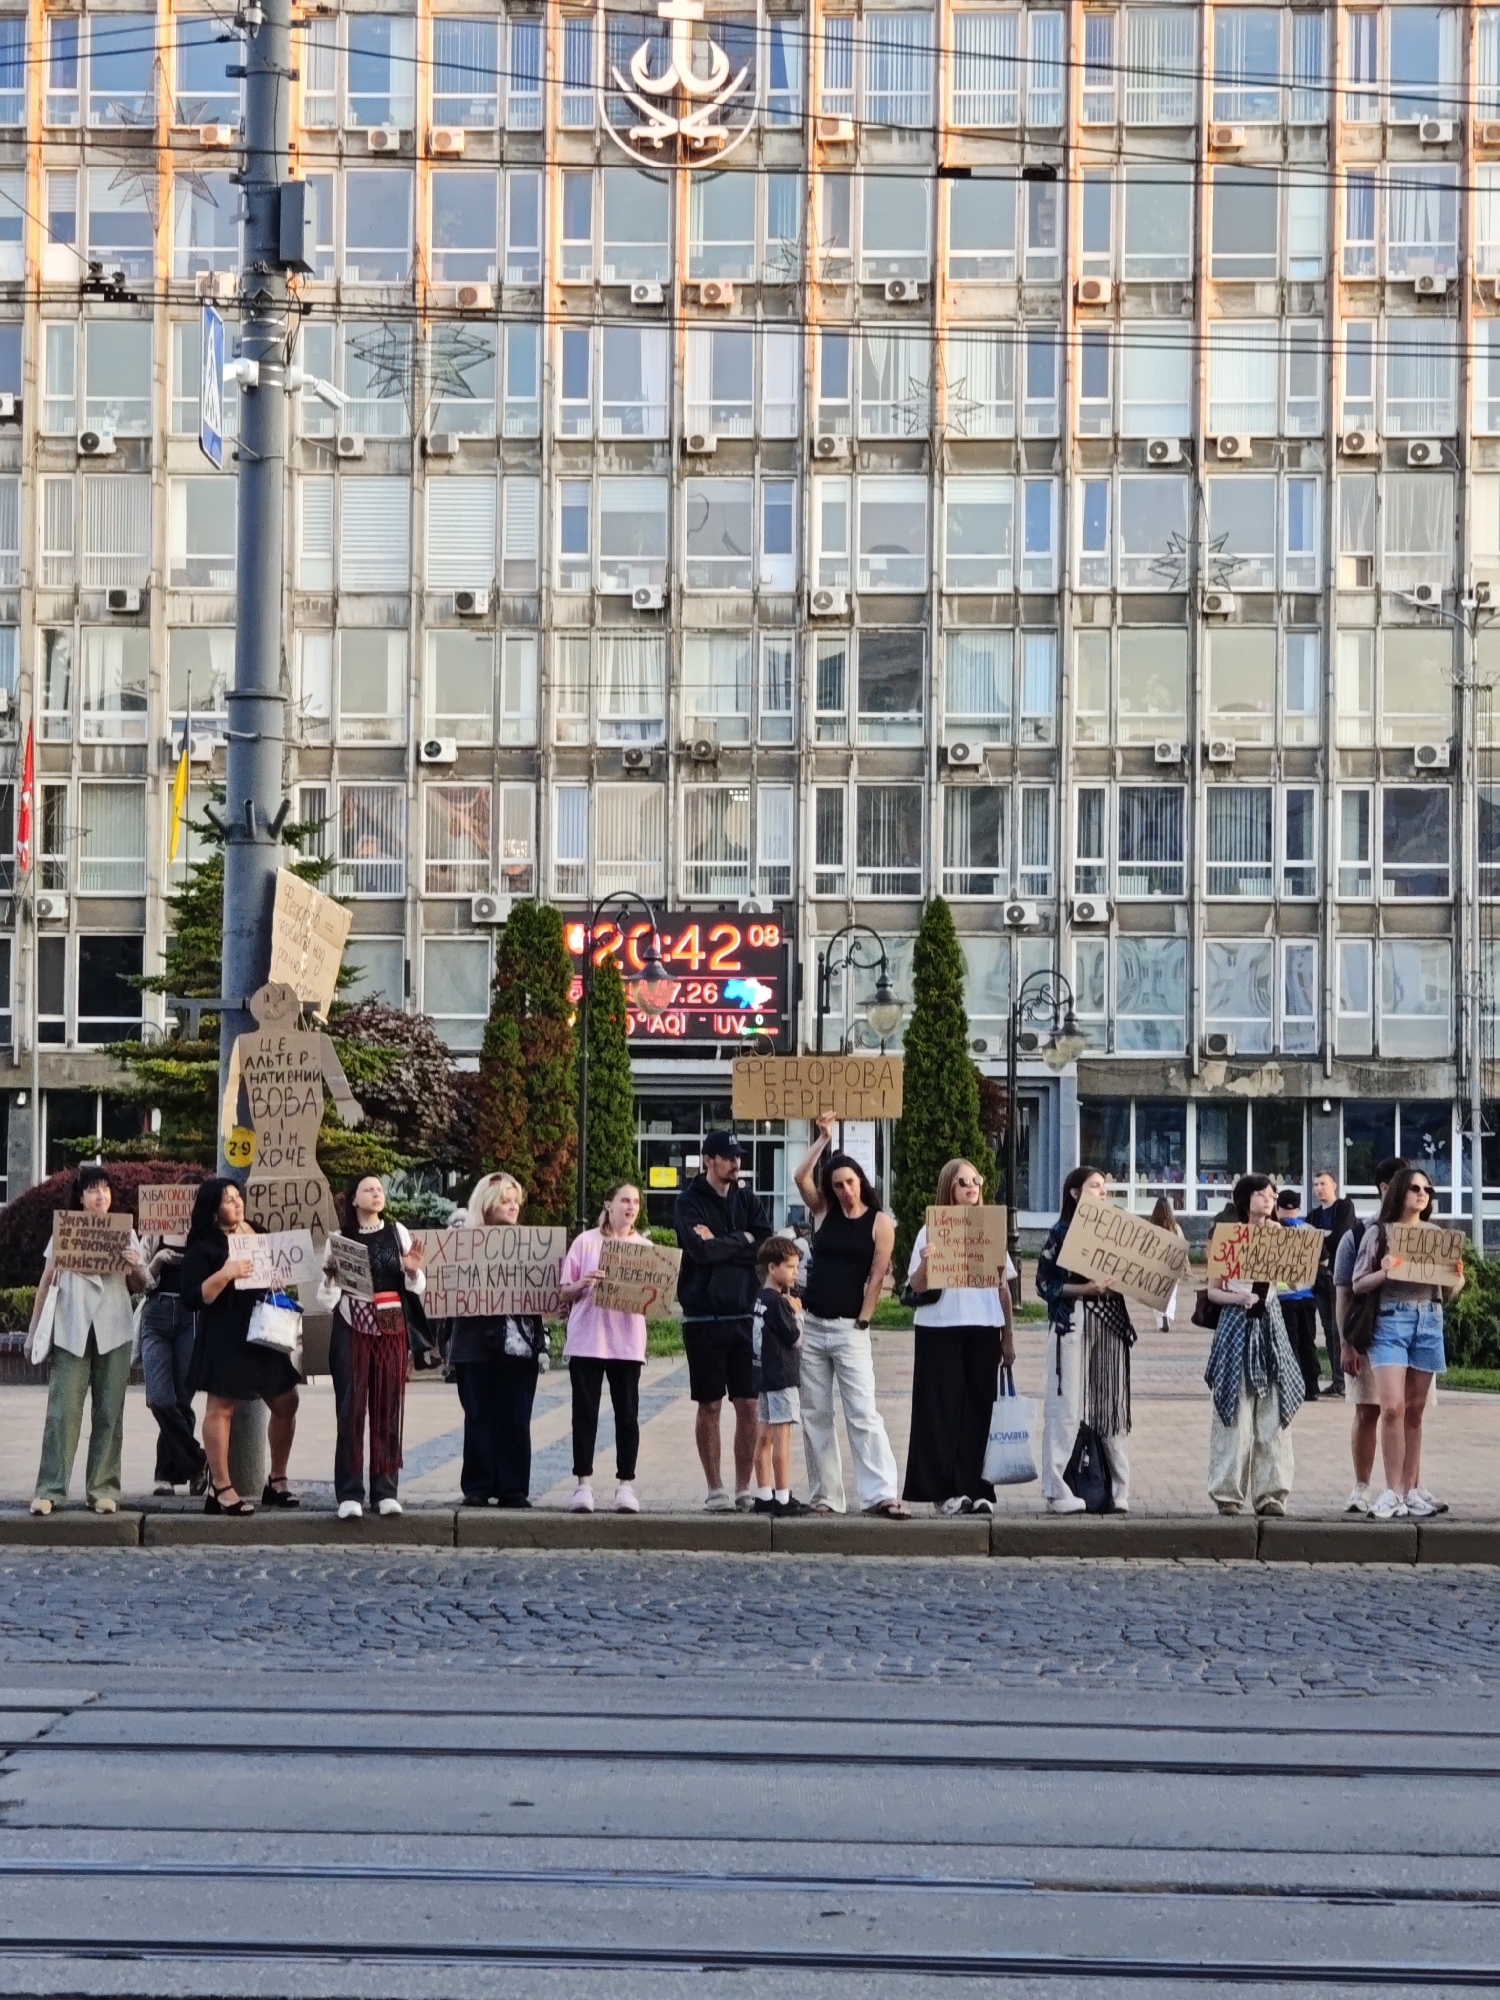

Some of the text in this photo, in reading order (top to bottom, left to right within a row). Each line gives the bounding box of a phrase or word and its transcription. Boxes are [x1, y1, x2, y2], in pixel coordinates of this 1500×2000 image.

[592, 922, 780, 972] 20:42 08
[650, 1014, 686, 1036] AQI
[717, 1014, 746, 1035] UV
[260, 1037, 286, 1053] ЦЕ
[249, 1066, 323, 1085] НАТИВНИЙ
[735, 1060, 895, 1090] ФЕДОРОВА
[252, 1086, 318, 1119] ВОВА
[229, 1141, 251, 1156] 29
[263, 1131, 298, 1147] ВІН
[257, 1146, 306, 1168] ХОЧЕ
[249, 1180, 322, 1213] ФЕДО
[430, 1227, 553, 1265] ХЕРСОНУ
[1228, 1225, 1250, 1244] ЗА
[1392, 1226, 1462, 1260] ФЕДОРОВ
[251, 1245, 304, 1268] БУЛО
[1213, 1241, 1236, 1262] ЗА
[425, 1263, 482, 1291] НЕМА
[615, 1266, 672, 1285] ПЕРЕМОГУ
[1089, 1247, 1178, 1299] ПЕРЕМОГА
[1220, 1261, 1242, 1280] ЗА
[1407, 1255, 1436, 1280] МО
[422, 1289, 448, 1316] АМ
[455, 1289, 505, 1315] ВОНИ
